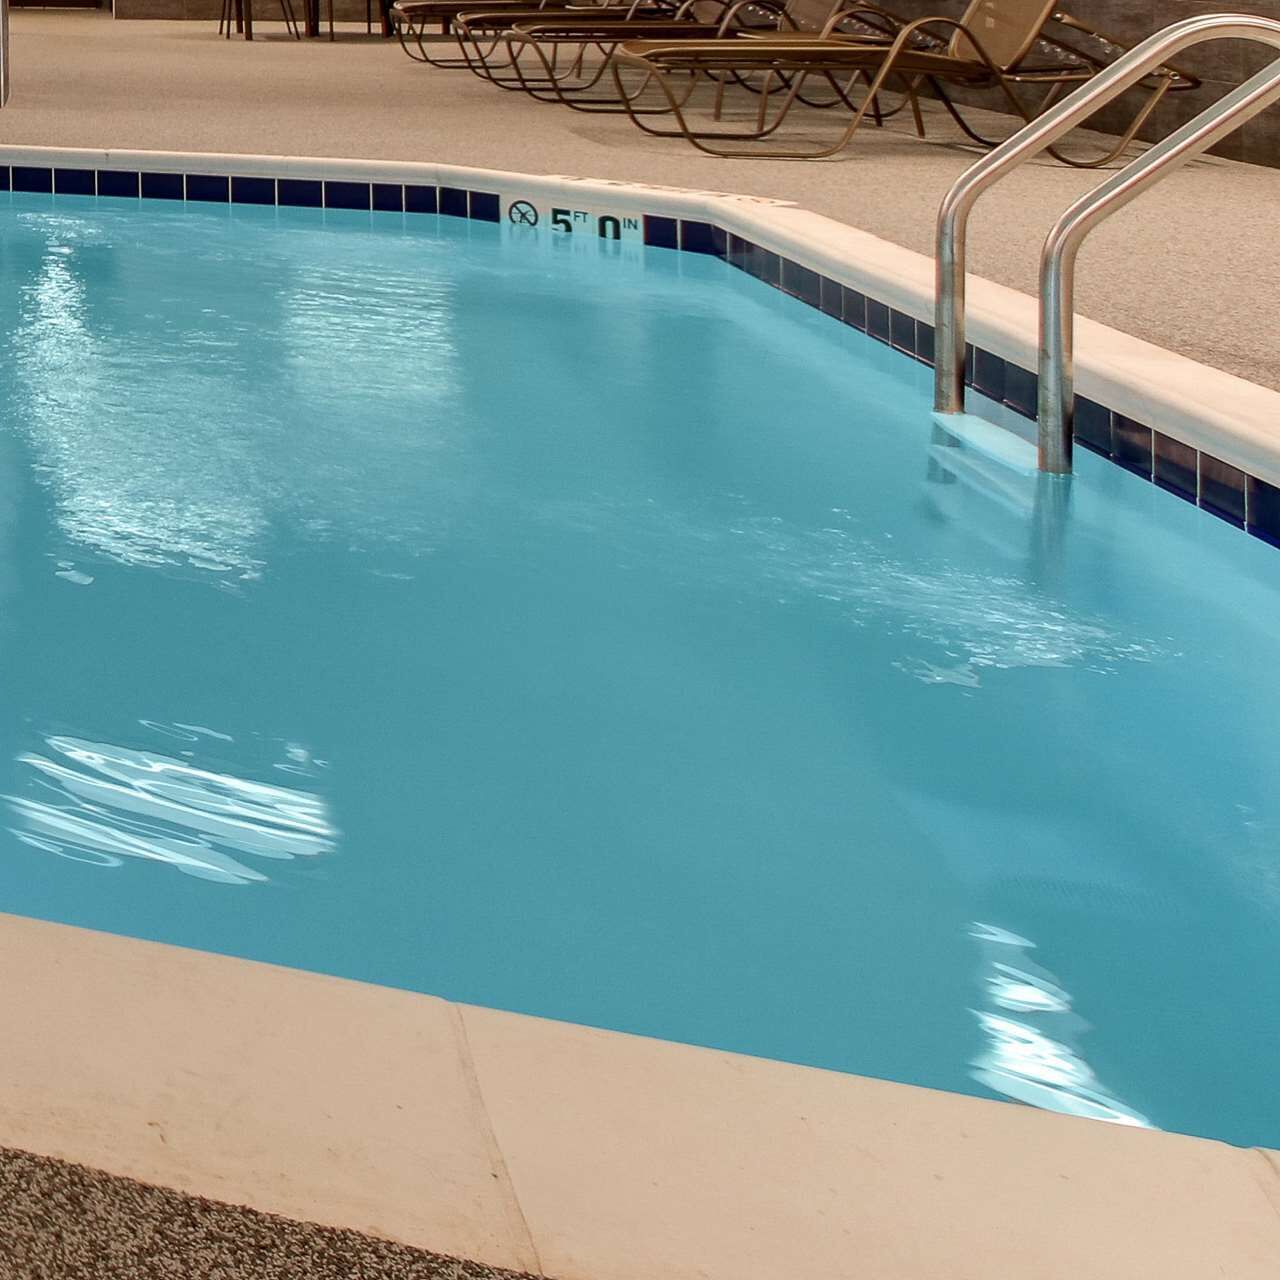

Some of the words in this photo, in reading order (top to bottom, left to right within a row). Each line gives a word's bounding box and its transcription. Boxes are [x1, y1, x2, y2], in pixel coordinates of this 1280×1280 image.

[551, 208, 573, 233] 5
[573, 211, 589, 224] FT
[598, 215, 621, 240] 0
[622, 217, 638, 231] IN
